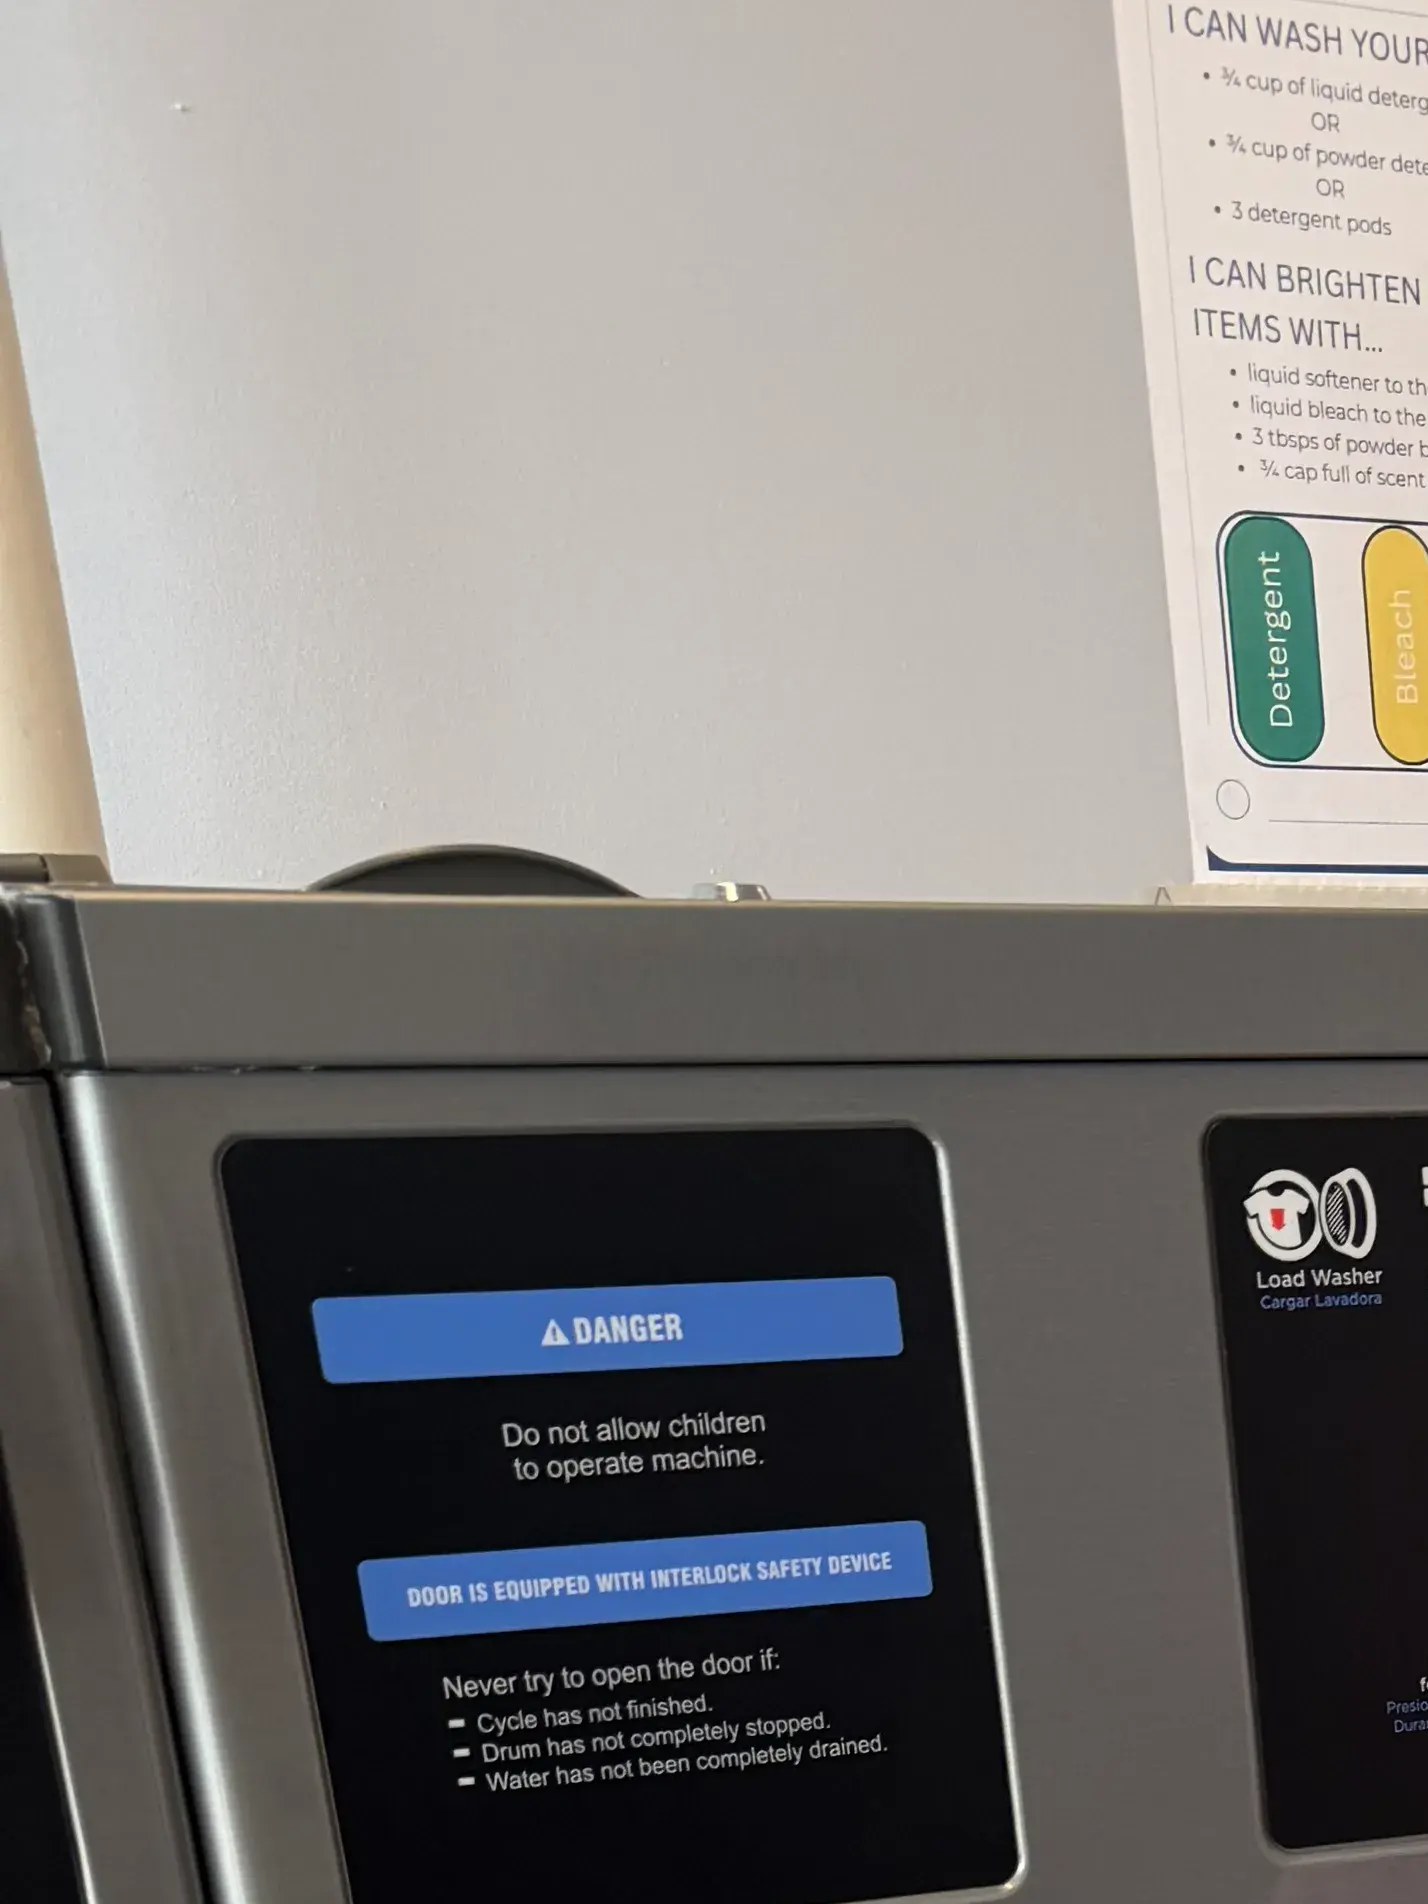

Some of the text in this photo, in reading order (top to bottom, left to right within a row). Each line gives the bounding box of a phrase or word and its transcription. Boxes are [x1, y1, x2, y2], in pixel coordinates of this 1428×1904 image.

[1168, 4, 1175, 34] I
[1184, 6, 1247, 43] CAN
[1255, 15, 1343, 56] WASH
[1245, 74, 1283, 97] cup
[1287, 76, 1306, 95] of
[1310, 78, 1364, 103] liquid
[1310, 111, 1340, 134] OR
[1189, 255, 1196, 284] I
[1205, 256, 1267, 291] CAN
[1276, 263, 1421, 306] BRIGHTEN
[1193, 308, 1281, 344] ITEMS
[1247, 362, 1300, 387] liquid
[1304, 369, 1380, 392] softener
[1384, 377, 1404, 395] to
[1257, 550, 1294, 728] Detergent
[1387, 587, 1420, 706] Bleach
[1256, 1267, 1383, 1289] Load Washer
[573, 1313, 684, 1345] DANGER
[501, 1411, 766, 1448] Do not allow children
[513, 1444, 764, 1484] to operate machine.
[406, 1551, 893, 1608] DOOR IS EQUIPPED WITH INTERLOCK SAFETY DEVICE
[442, 1647, 780, 1700] Never try to open the door if:
